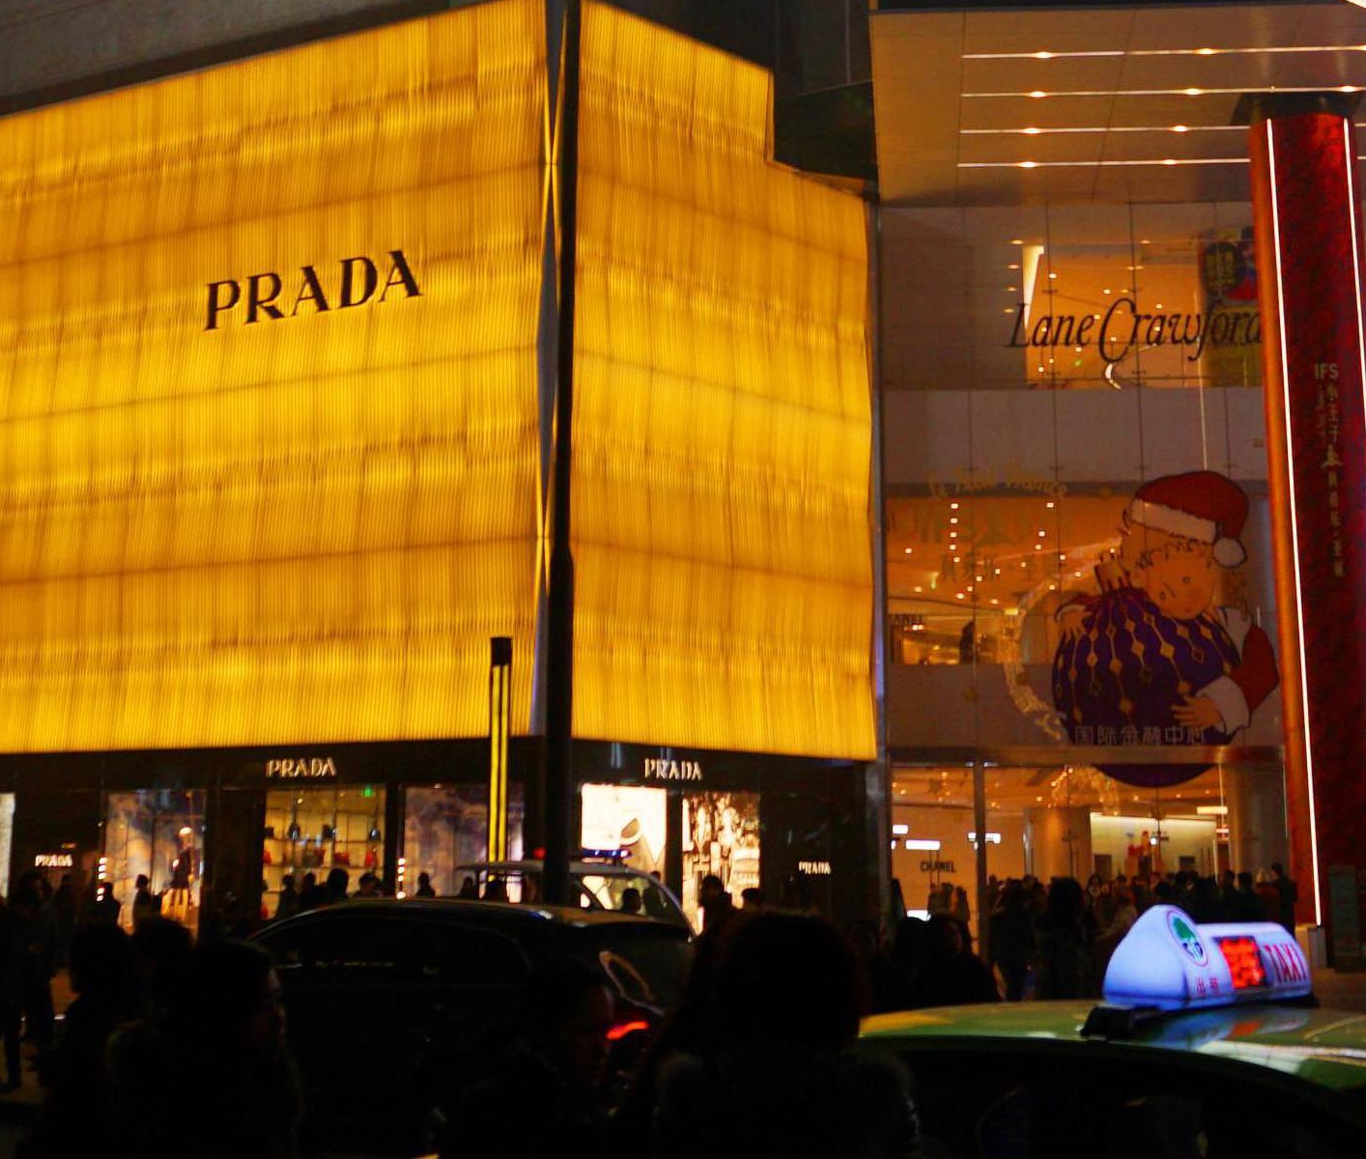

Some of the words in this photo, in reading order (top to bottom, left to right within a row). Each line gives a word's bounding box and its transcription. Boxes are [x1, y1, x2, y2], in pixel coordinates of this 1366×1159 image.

[204, 249, 424, 331] PRADA
[1005, 302, 1095, 348] Lane
[1314, 363, 1339, 379] IFS
[266, 757, 337, 778] PRADA
[644, 757, 703, 781] PRADA
[1264, 943, 1307, 985] TAXI
